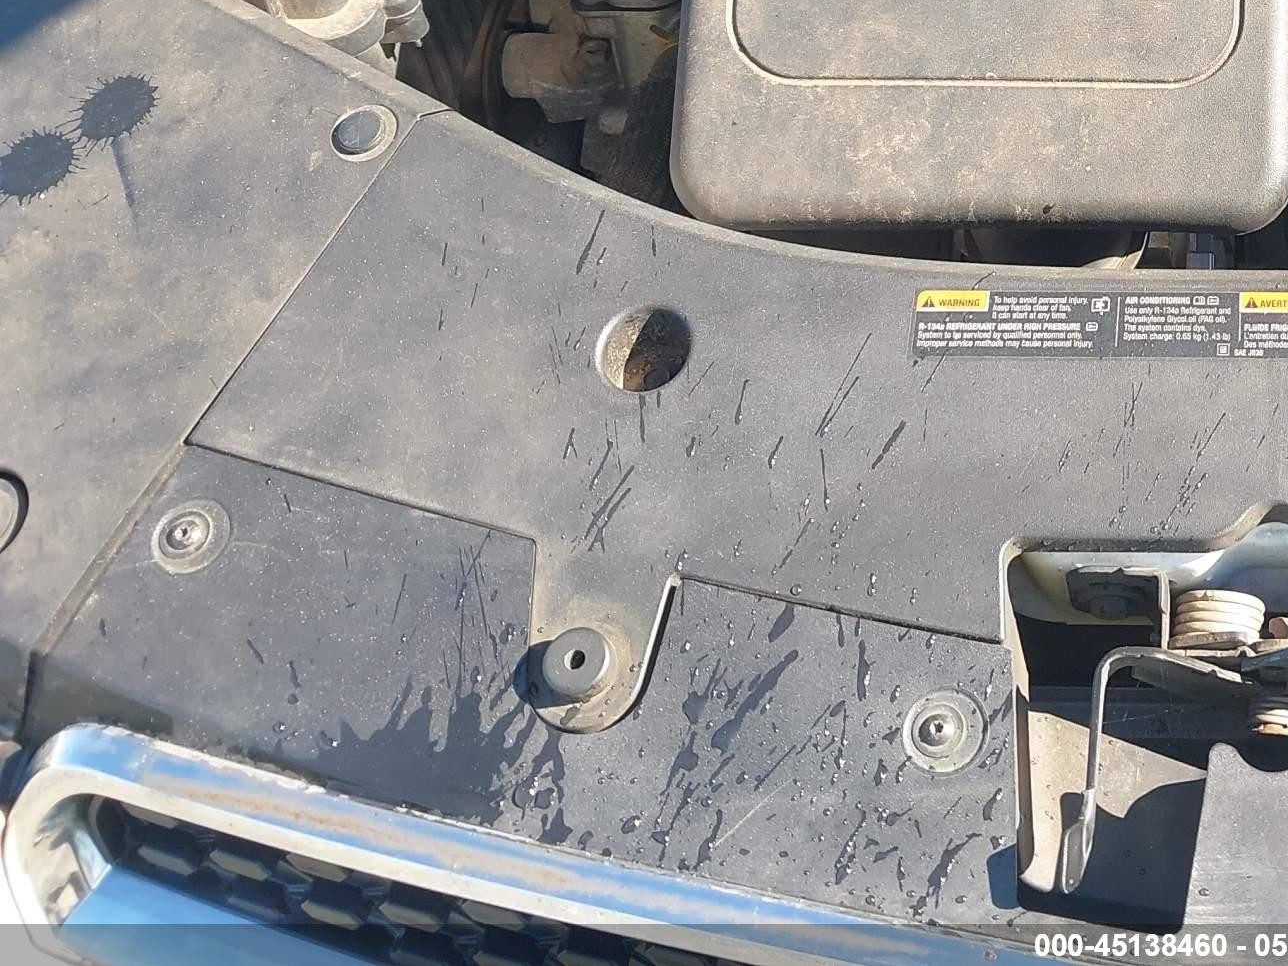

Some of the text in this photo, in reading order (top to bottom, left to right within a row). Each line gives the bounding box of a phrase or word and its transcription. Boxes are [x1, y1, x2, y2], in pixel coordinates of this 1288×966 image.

[938, 298, 980, 307] WARNING
[1003, 296, 1017, 304] help
[1038, 296, 1067, 304] personal
[1068, 296, 1088, 304] injury.
[1138, 307, 1153, 316] only
[1180, 307, 1217, 316] Refrigerant
[1005, 340, 1020, 348] may
[1042, 340, 1072, 348] personal
[1073, 340, 1094, 348] injury.
